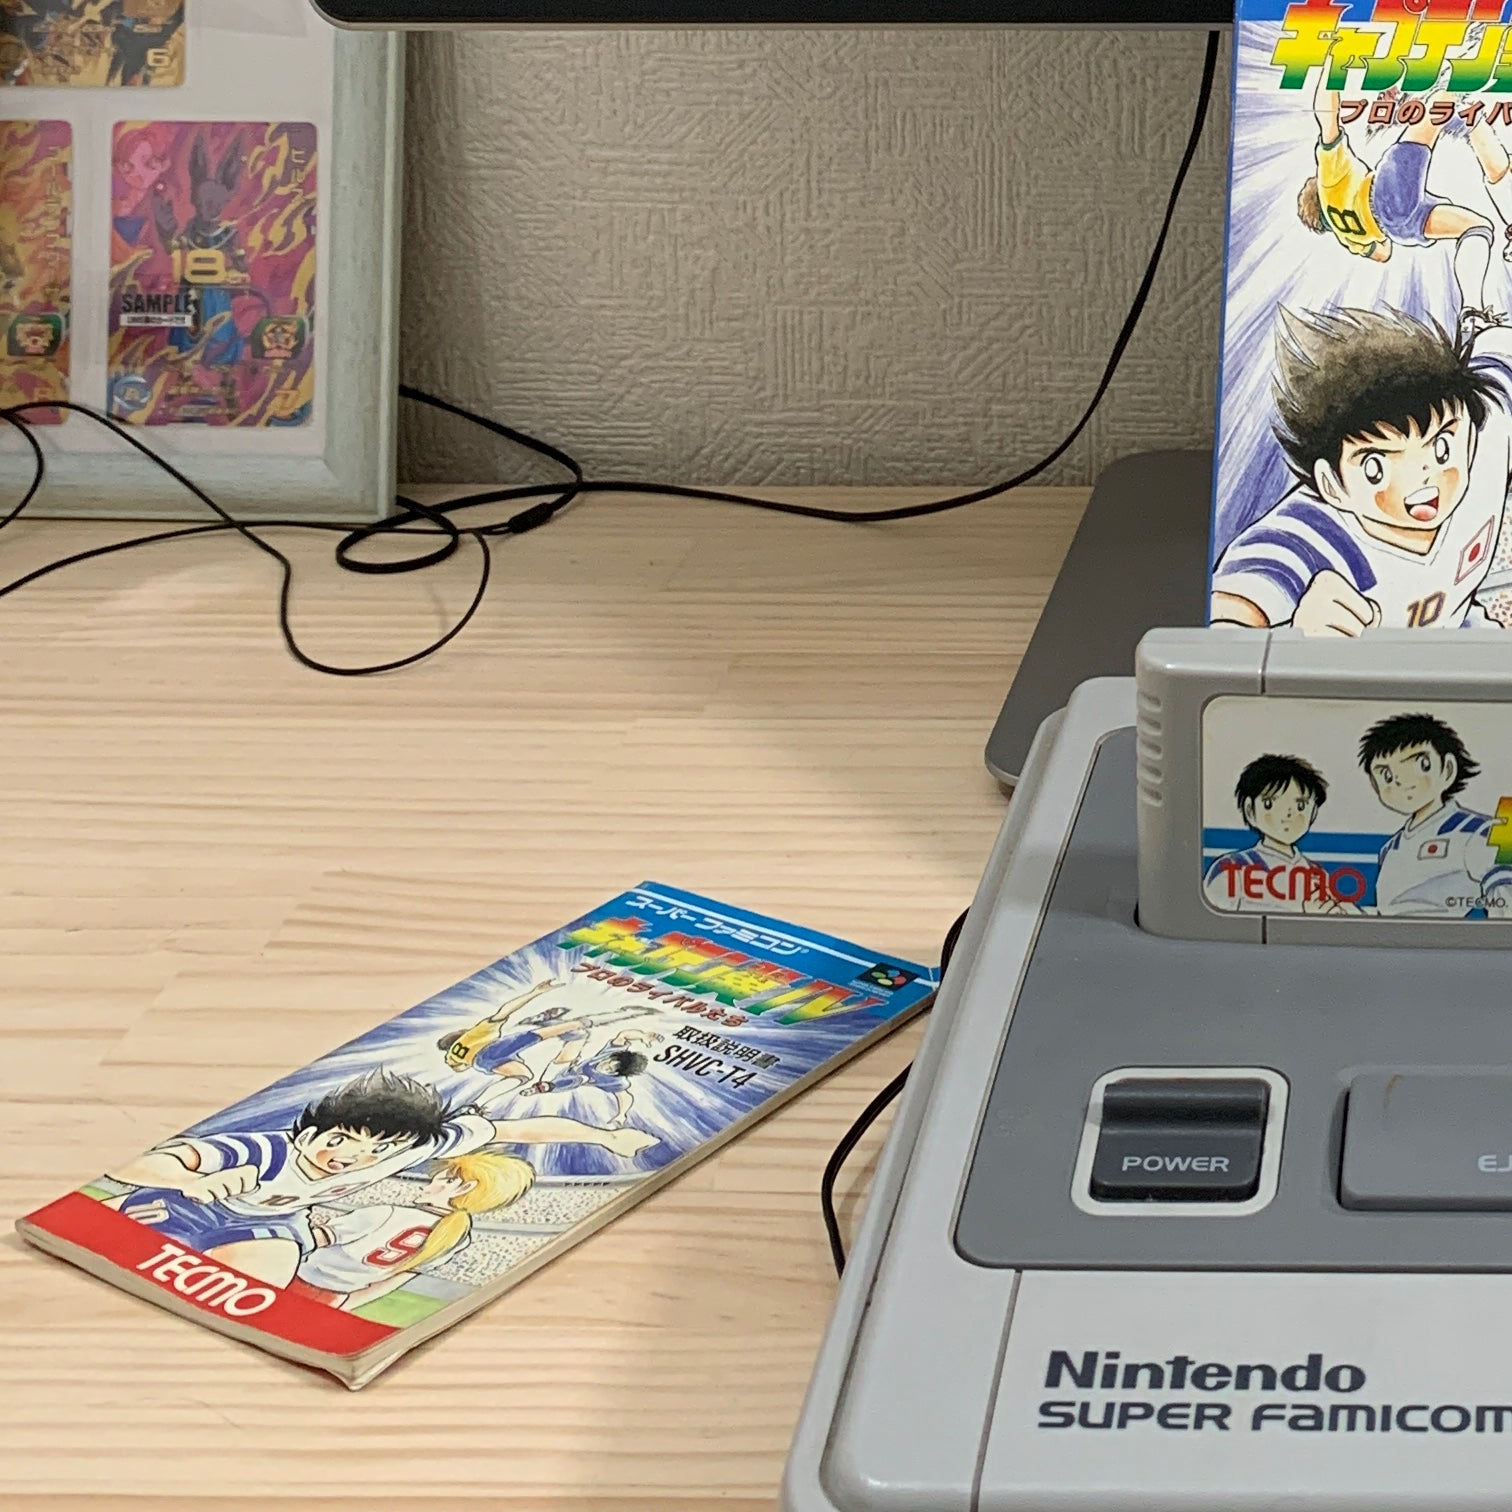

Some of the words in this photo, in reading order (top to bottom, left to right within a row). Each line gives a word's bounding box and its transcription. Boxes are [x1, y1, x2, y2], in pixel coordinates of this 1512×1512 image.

[121, 293, 195, 314] SAMPLE
[1406, 590, 1447, 628] 10
[1220, 862, 1368, 904] TECMO
[570, 962, 749, 1027] プロのライバルたち
[652, 1044, 759, 1089] SHVC-T4
[672, 1024, 782, 1070] 取扱説明書
[1120, 1152, 1231, 1174] POWER
[136, 1242, 277, 1317] TECMO
[1044, 1350, 1366, 1394] Nintendo
[1037, 1400, 1232, 1432] SUPER
